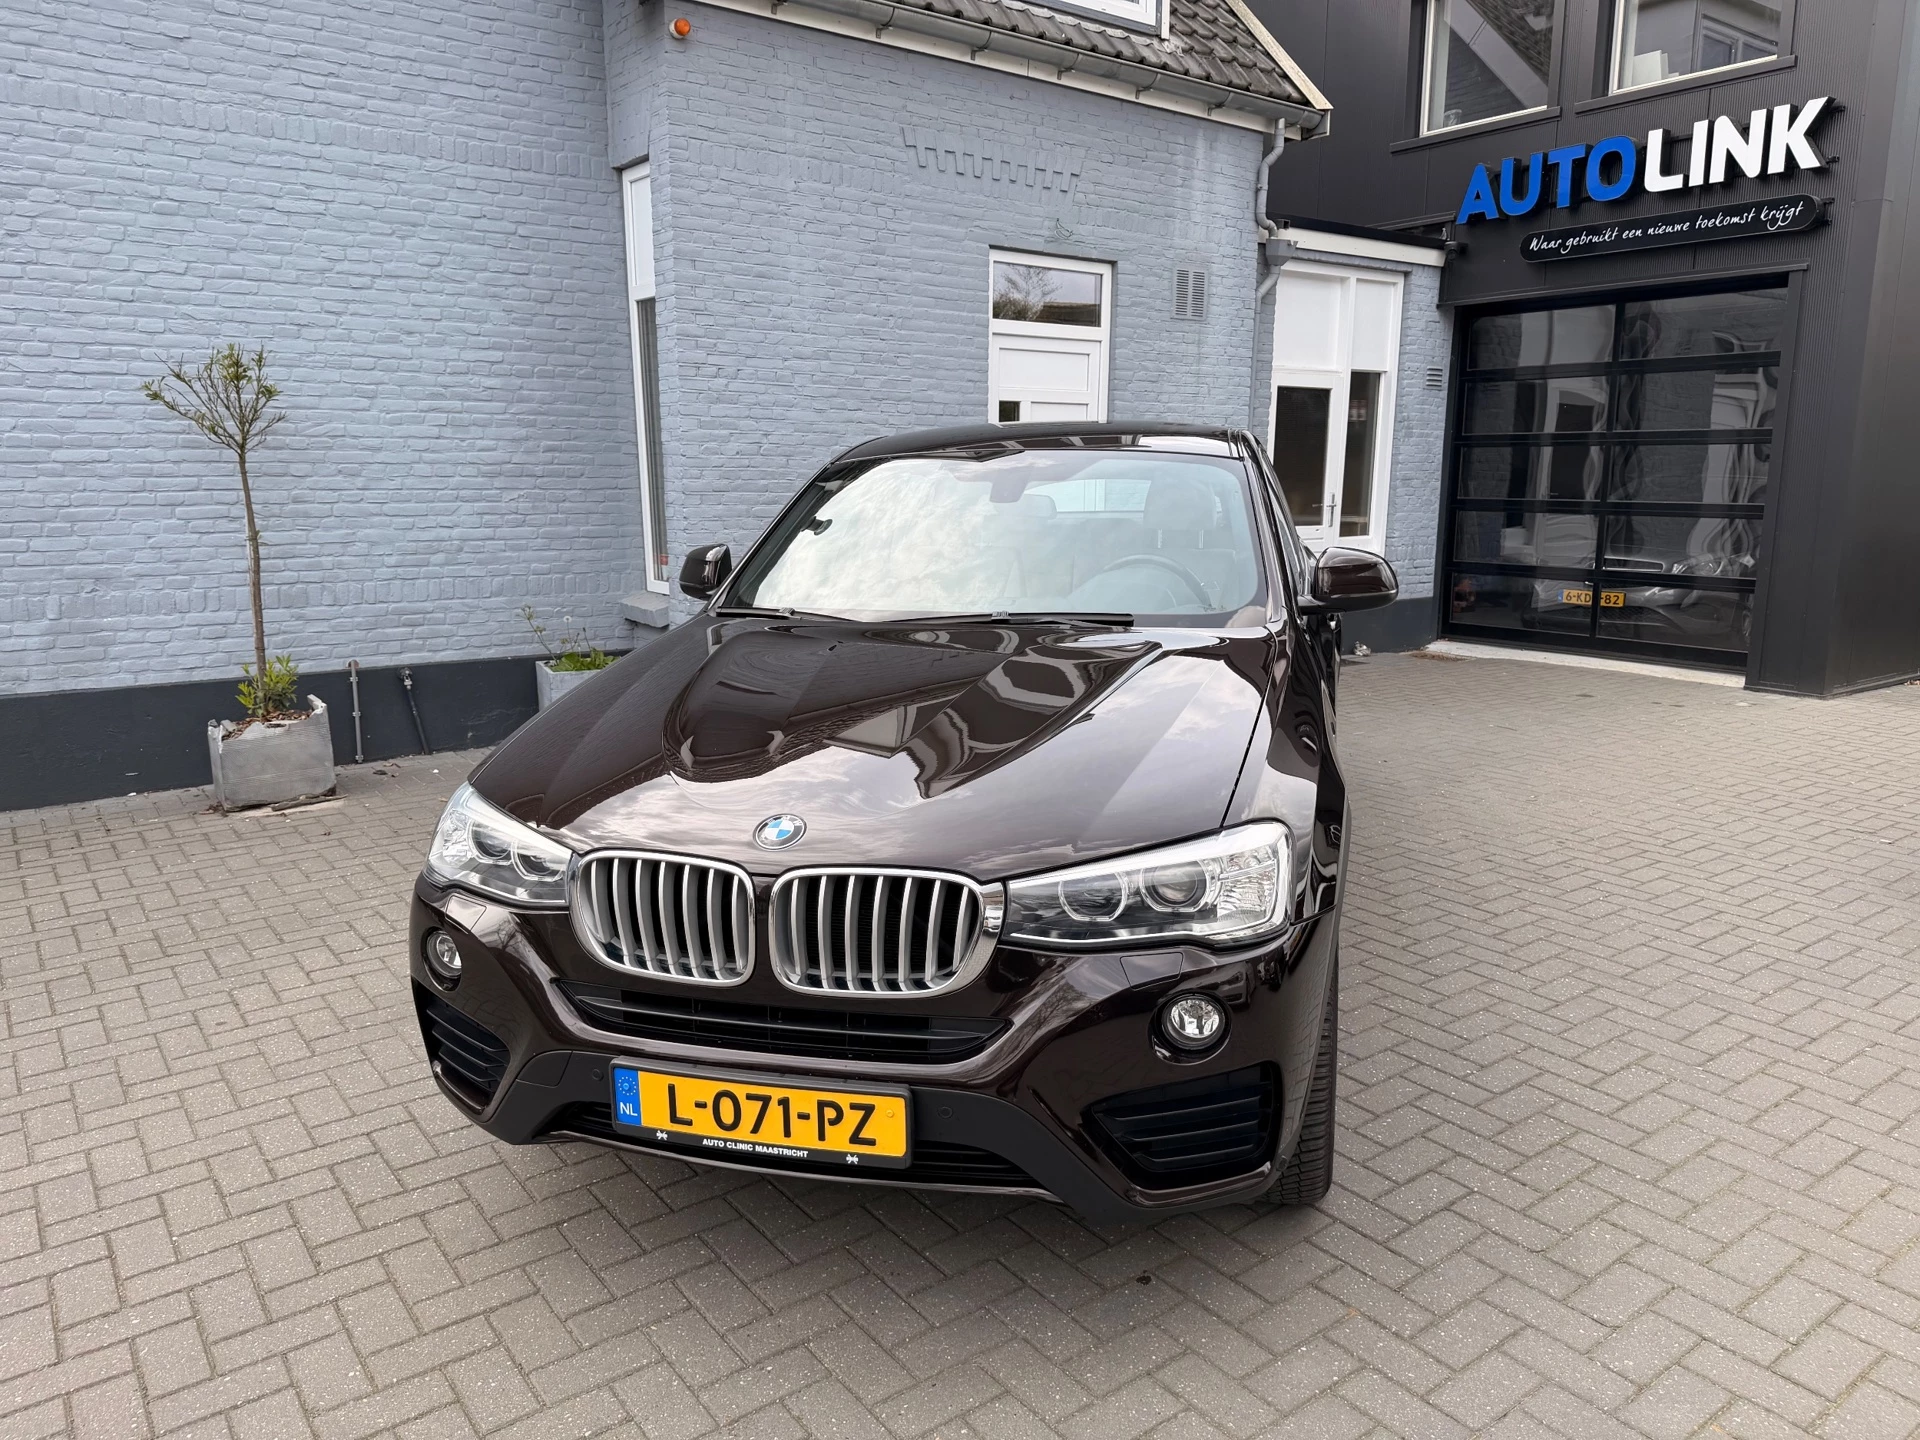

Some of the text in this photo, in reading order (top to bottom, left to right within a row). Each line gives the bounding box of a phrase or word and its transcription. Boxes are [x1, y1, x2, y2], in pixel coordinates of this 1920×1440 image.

[1456, 96, 1835, 225] AUTOLINK
[1529, 201, 1804, 254] Waar gebruikt een nieuwe toekomst krijgt
[1565, 591, 1620, 605] 6-KD-82
[620, 1083, 877, 1147] NL L-071-PZ
[702, 1138, 809, 1158] AUTO CLINIC MAASTRICHT
